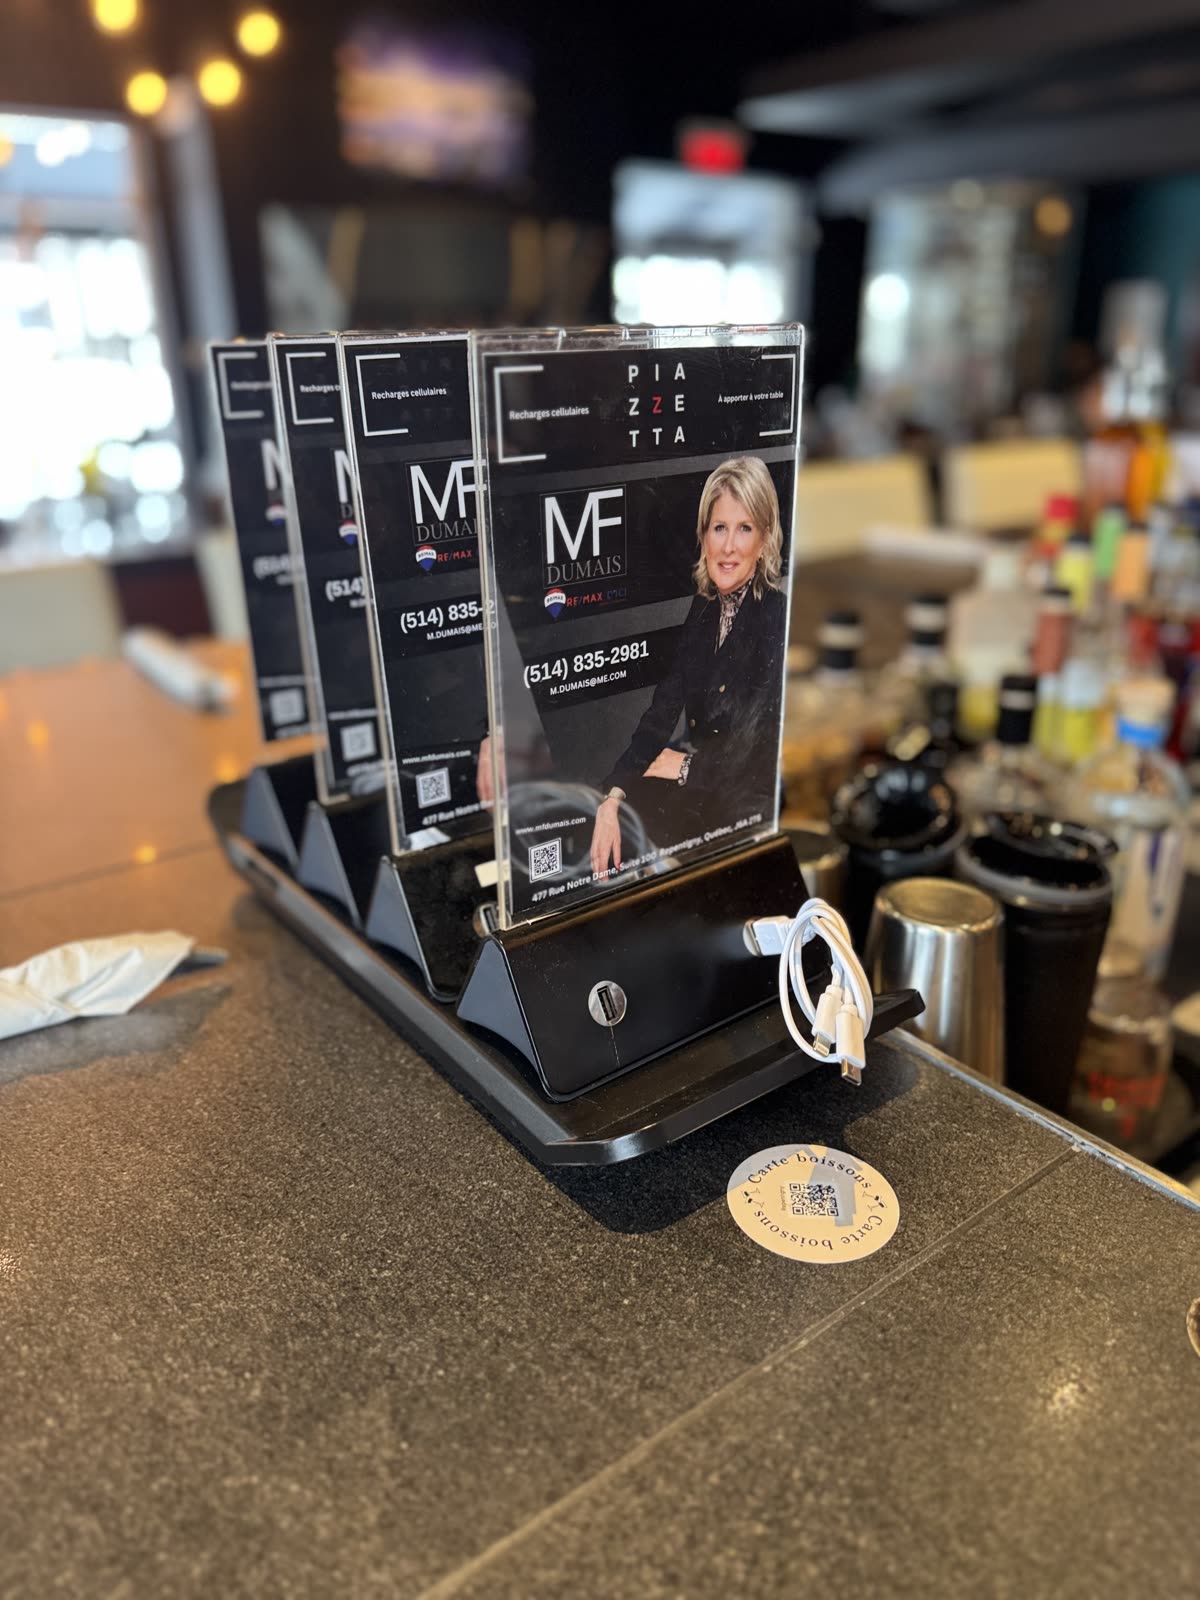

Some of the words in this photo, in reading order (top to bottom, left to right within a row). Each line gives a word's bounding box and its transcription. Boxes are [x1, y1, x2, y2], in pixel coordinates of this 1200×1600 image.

[371, 390, 409, 400] Recharges
[410, 387, 447, 398] cellulaires
[723, 394, 749, 405] apporter
[749, 392, 753, 401] à
[753, 392, 769, 400] votre
[769, 390, 784, 399] table
[509, 409, 550, 421] Recharges
[551, 406, 589, 417] cellulaires
[416, 518, 486, 542] DUMAI
[544, 488, 624, 564] MF
[547, 555, 621, 585] DUMAIS
[400, 607, 444, 634] (514)
[448, 600, 495, 621] 835-2
[523, 657, 568, 688] (514)
[573, 640, 649, 673] 835-2981
[550, 669, 627, 696] M.DUMAIS@ME.COM
[515, 817, 587, 835] www.mfdumais.com
[531, 889, 548, 902] 477
[548, 885, 565, 897] Rue
[566, 875, 591, 891] Notre
[747, 1157, 789, 1184] Carte
[796, 1153, 872, 1189] boissons
[754, 1210, 833, 1250] boissons
[840, 1215, 883, 1244] Carte
